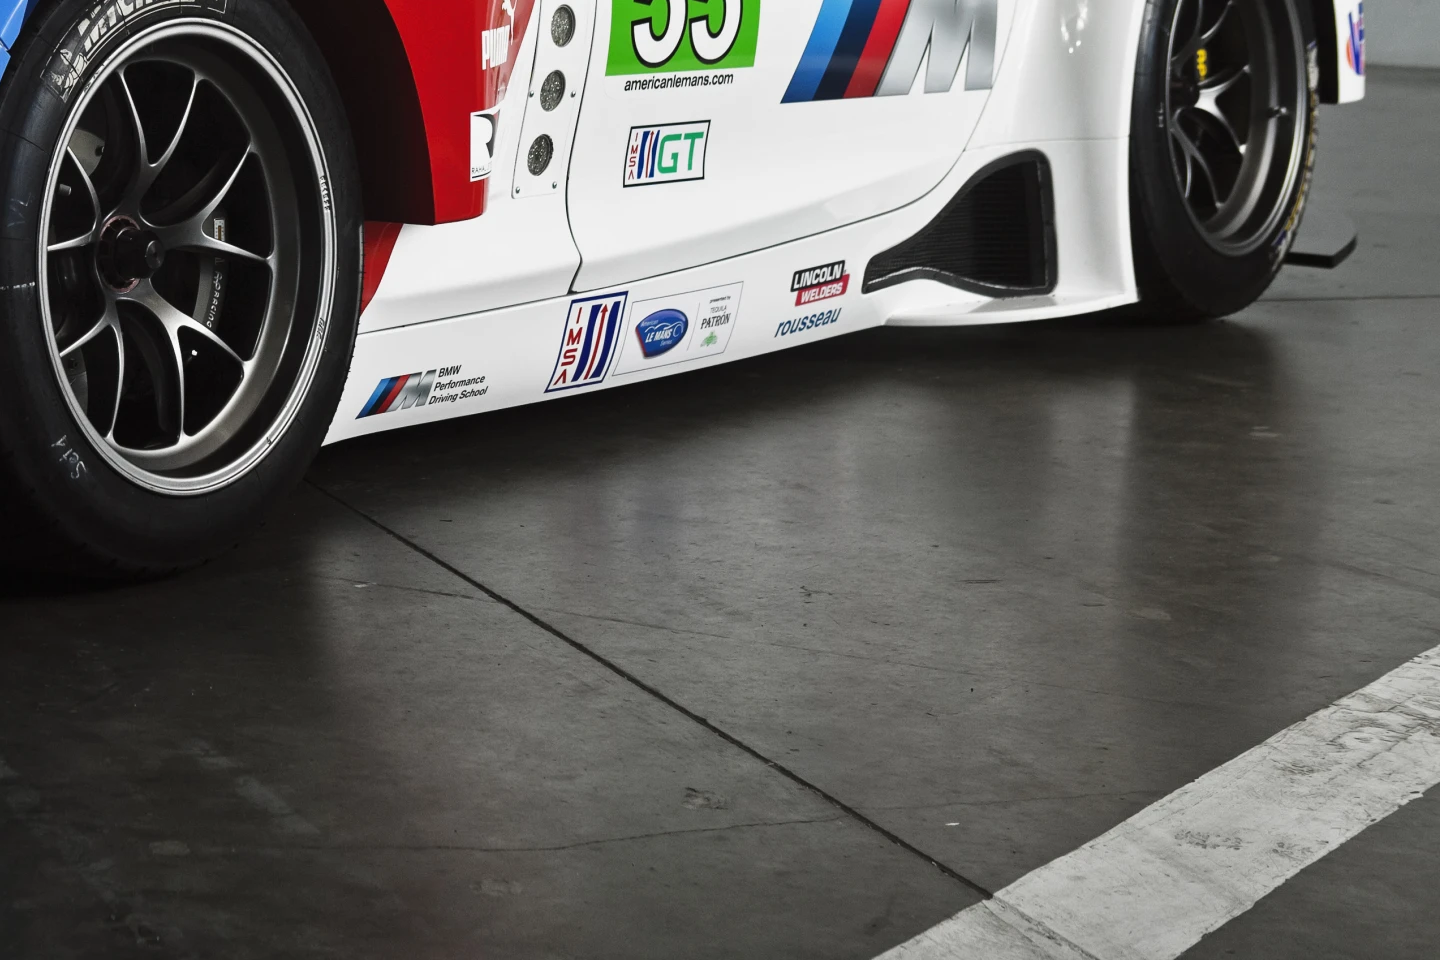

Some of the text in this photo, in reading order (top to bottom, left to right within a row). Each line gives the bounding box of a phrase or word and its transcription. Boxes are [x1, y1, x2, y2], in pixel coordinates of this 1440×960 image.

[481, 24, 510, 71] PUMA
[623, 73, 734, 92] americanlemans.com
[657, 131, 704, 174] GT
[793, 263, 843, 290] LINCOLN
[801, 282, 844, 304] WELDERS
[774, 307, 842, 338] rousseau
[553, 307, 583, 386] IMSA
[645, 328, 674, 343] LE MANS
[438, 364, 462, 378] BMW
[433, 375, 486, 392] Performance
[428, 385, 489, 405] Driving School
